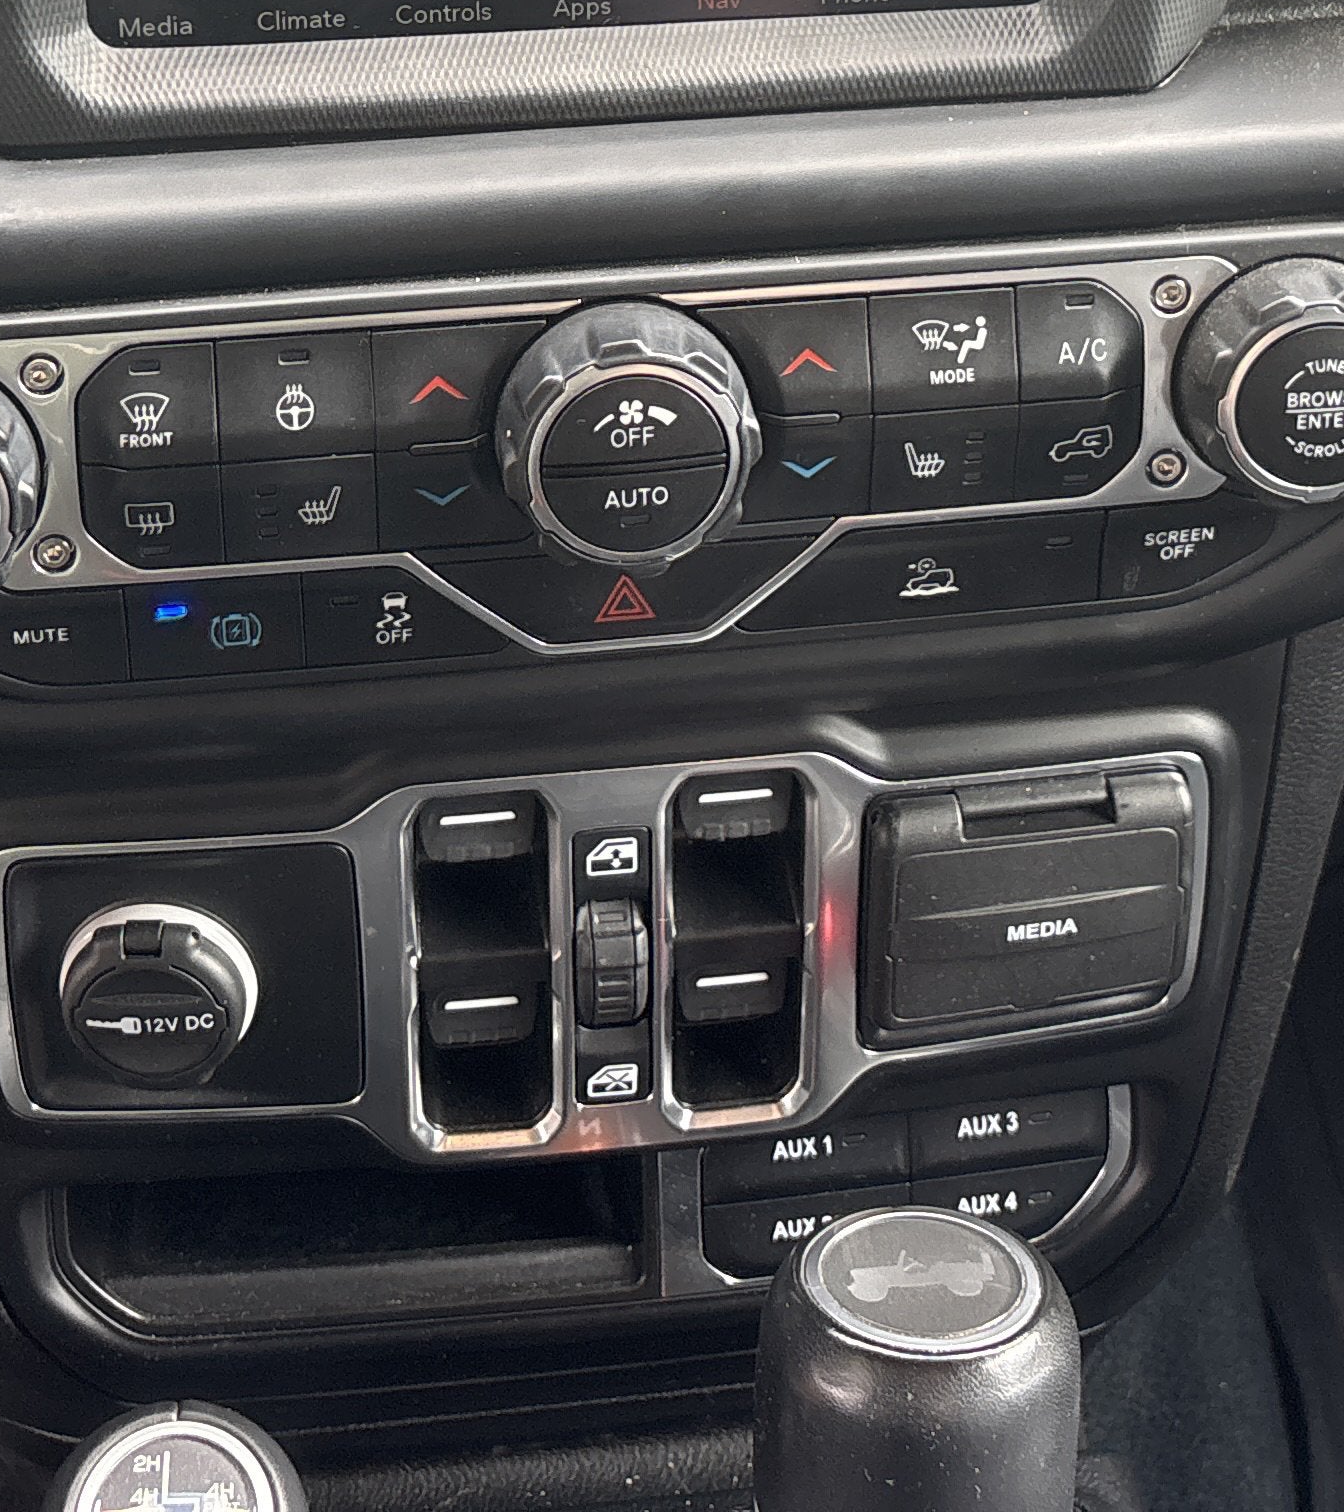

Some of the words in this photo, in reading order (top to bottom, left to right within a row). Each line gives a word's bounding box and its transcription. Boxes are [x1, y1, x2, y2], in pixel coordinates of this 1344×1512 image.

[257, 10, 346, 33] Climate
[394, 3, 493, 26] Controls
[118, 16, 194, 38] Media
[1058, 337, 1107, 365] A/C
[929, 367, 976, 385] MODE
[119, 431, 173, 449] FRONT
[610, 425, 655, 449] OFF
[604, 486, 669, 509] AUTO
[1144, 526, 1215, 546] SCREEN
[1159, 543, 1195, 561] OFF
[13, 626, 69, 646] MUTE
[375, 627, 413, 645] OFF
[1006, 918, 1078, 942] MEDIA
[144, 1017, 178, 1032] 12V
[185, 1013, 214, 1031] DC
[959, 1114, 1001, 1137] AUX
[1005, 1111, 1019, 1132] 3
[772, 1137, 817, 1161] AUX
[823, 1135, 833, 1156] 1
[958, 1194, 1001, 1214] AUX
[1004, 1191, 1018, 1211] 4
[772, 1216, 815, 1241] AUX
[133, 1455, 161, 1472] 2H
